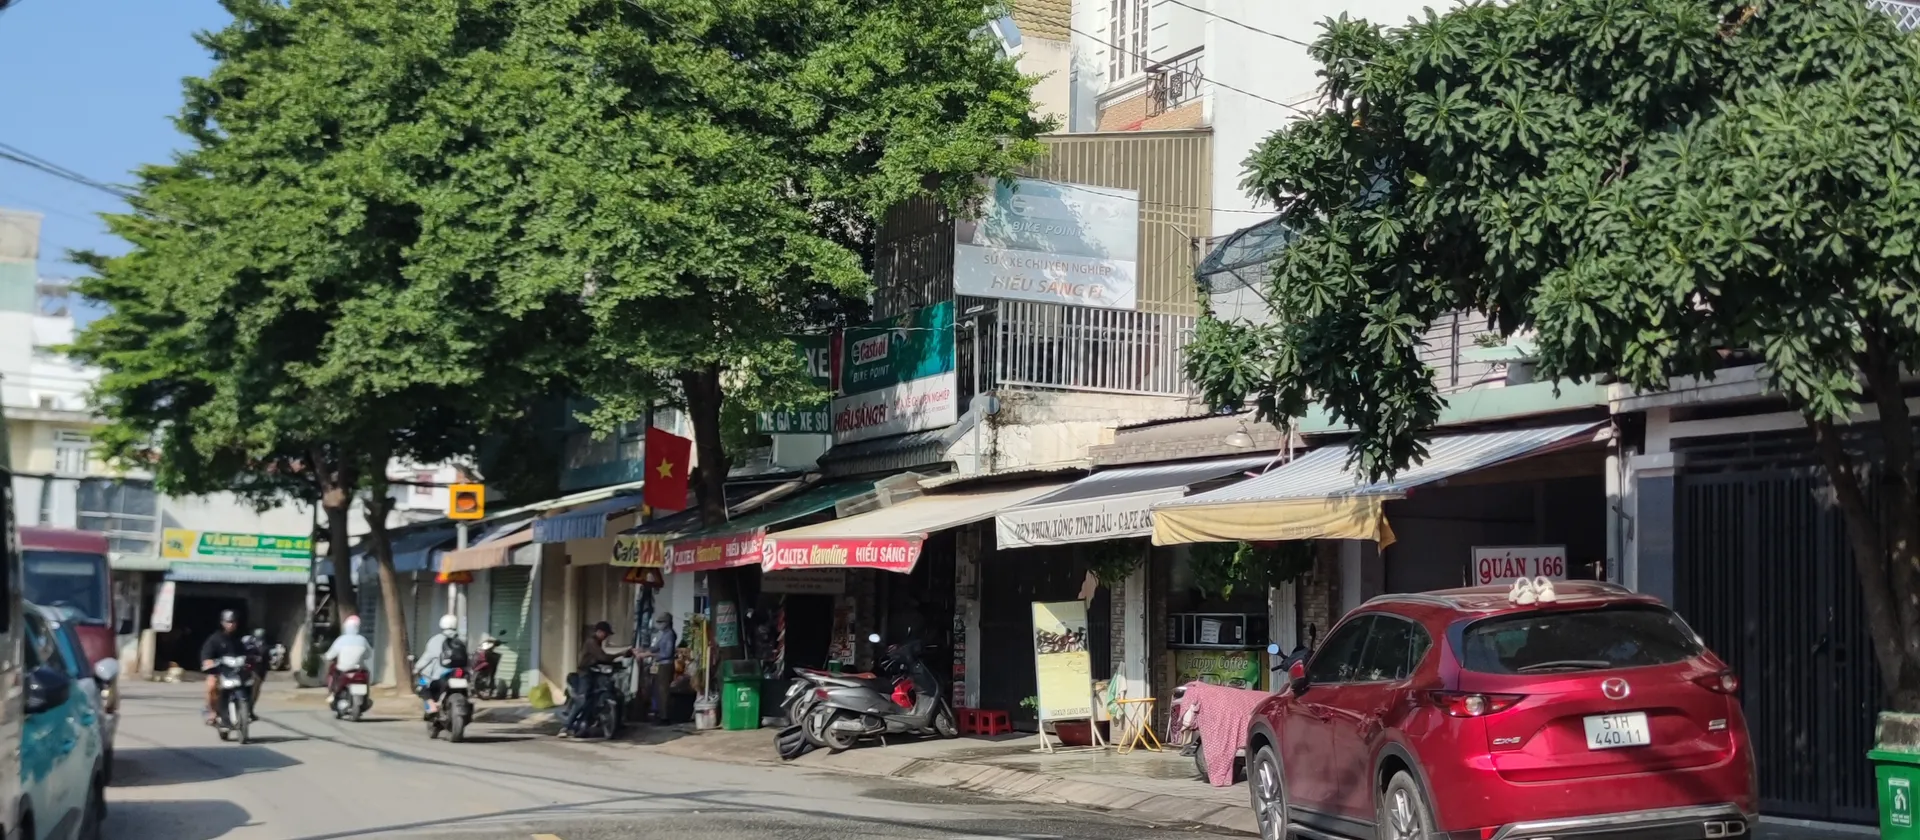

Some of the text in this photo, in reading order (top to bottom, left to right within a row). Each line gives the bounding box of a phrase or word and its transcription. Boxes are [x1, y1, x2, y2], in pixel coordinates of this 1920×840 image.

[1012, 221, 1040, 233] BIKE
[1009, 256, 1022, 267] XE
[861, 338, 886, 360] Castrol
[805, 348, 829, 378] XE
[853, 365, 890, 382] BIKE POINT
[761, 411, 774, 430] XE
[777, 411, 790, 431] GA
[800, 411, 812, 430] XE
[815, 405, 829, 431] SỐ
[1076, 515, 1094, 534] TINH
[1118, 510, 1139, 530] CAFE
[613, 540, 639, 562] Café
[674, 549, 695, 566] CALTEX
[777, 548, 808, 565] CALTEX
[810, 544, 848, 565] Havoline
[856, 541, 877, 562] HIẾU
[879, 543, 905, 562] SÁNG
[1479, 552, 1563, 584] QUÁN 166
[1184, 655, 1249, 672] Happy Coffee
[1602, 716, 1630, 729] 51H
[1595, 729, 1641, 745] 440.11
